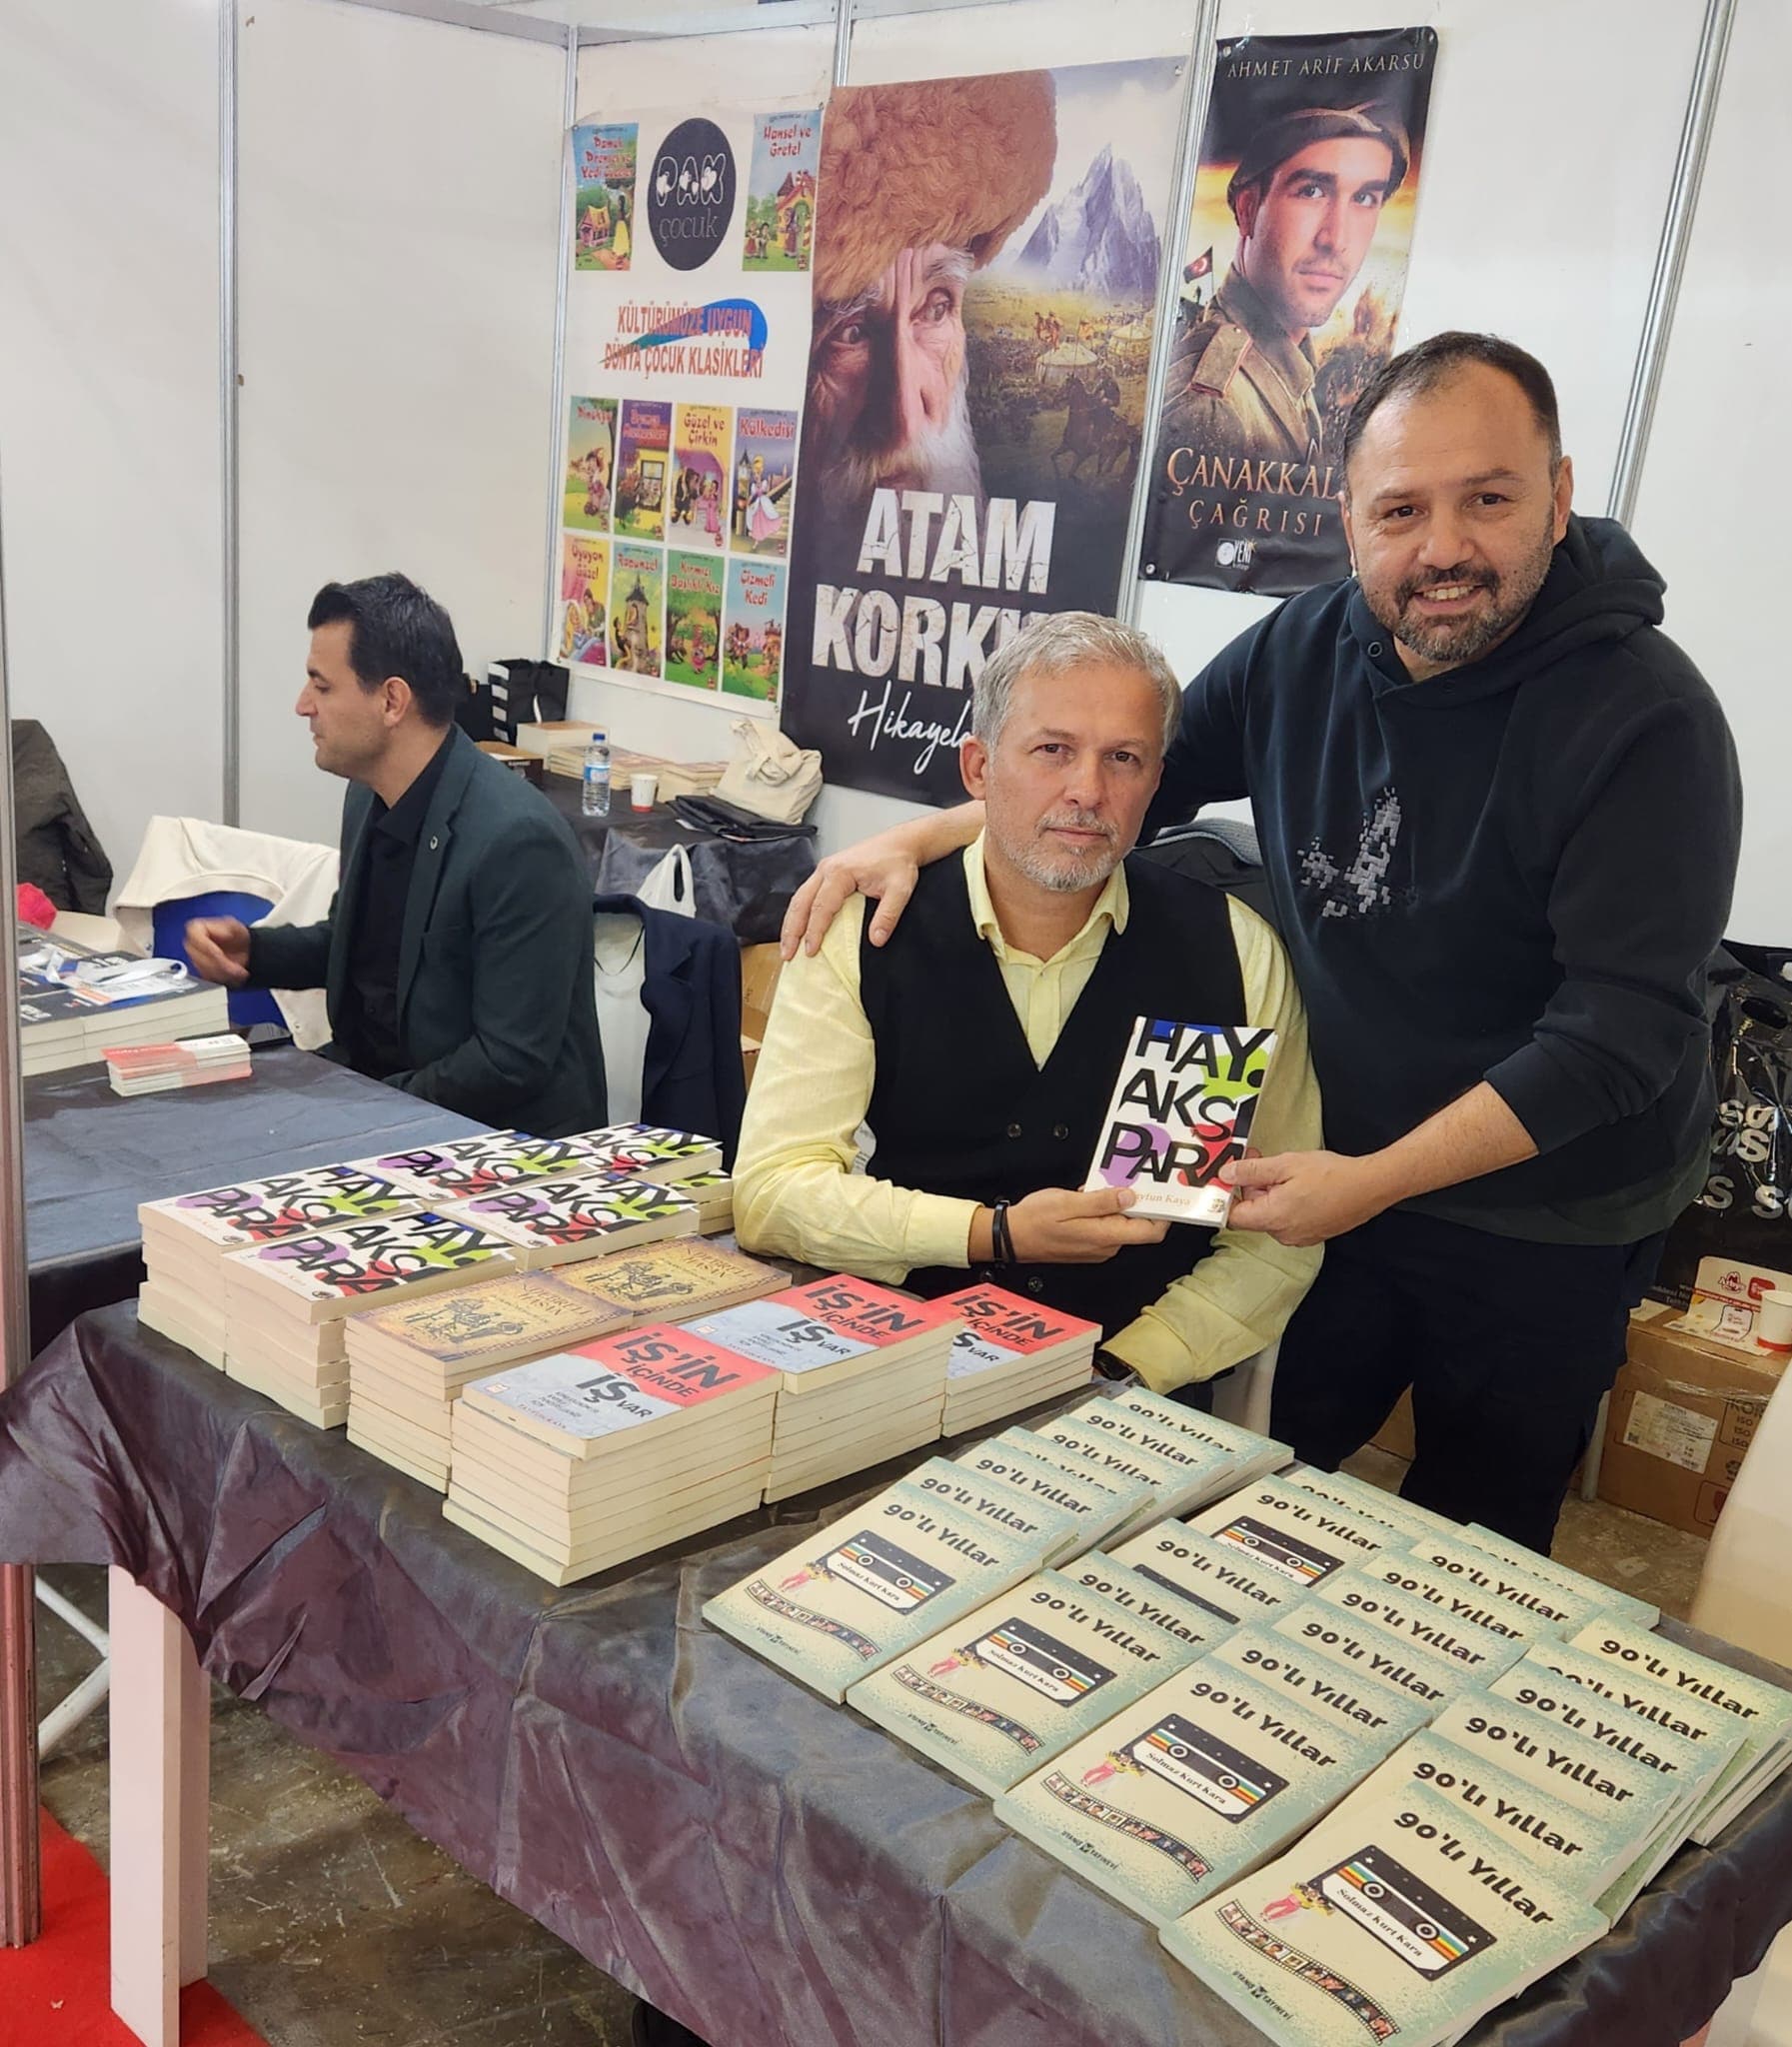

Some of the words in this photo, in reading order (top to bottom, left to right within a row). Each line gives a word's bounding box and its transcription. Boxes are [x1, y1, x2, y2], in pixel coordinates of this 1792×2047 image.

[1228, 59, 1292, 78] AHMET
[1299, 56, 1344, 77] ARİF
[1350, 53, 1425, 73] AKARSU
[770, 141, 802, 157] Gretel
[660, 207, 719, 247] çocuk
[617, 301, 705, 336] KÜLTÜRÜMÜZE
[707, 308, 753, 338] UYGUN
[603, 338, 642, 372] DÜNYA
[643, 345, 686, 380] ÇOCUK
[688, 340, 764, 379] KLASİKLERİ
[684, 413, 711, 429] Güzel
[714, 420, 726, 432] ve
[1166, 446, 1339, 500] ÇANAKKAL
[1188, 497, 1323, 537] ÇAĞRISI
[857, 487, 1056, 594] ATAM
[813, 584, 1049, 690] KORK
[382, 1149, 502, 1195] PARA
[186, 1187, 312, 1238] PARA
[475, 1191, 603, 1244] PARA
[268, 1235, 401, 1296] PARA
[820, 1309, 892, 1340] İÇİNDE
[967, 1318, 1034, 1346] İÇİNDE
[818, 1339, 852, 1355] VAR
[967, 1347, 1000, 1362] VAR
[626, 1363, 702, 1399] İÇİNDE
[616, 1400, 655, 1419] VAR
[1140, 1433, 1200, 1466] Yıllar
[1030, 1478, 1092, 1514] Yıllar
[975, 1501, 1038, 1535] Yıllar
[1315, 1515, 1383, 1552] Yıllar
[936, 1526, 1000, 1567] Yıllar
[1214, 1566, 1282, 1607] Yıllar
[1495, 1581, 1570, 1624] Yıllar
[1136, 1603, 1206, 1646] Yıllar
[1448, 1597, 1525, 1641] Yıllar
[1090, 1618, 1163, 1664] Yıllar
[1409, 1619, 1487, 1666] Yıllar
[1367, 1652, 1446, 1701] Yıllar
[1676, 1670, 1761, 1722] Yıllar
[1307, 1680, 1389, 1729] Yıllar
[1257, 1713, 1338, 1768] Yıllar
[1592, 1721, 1679, 1776] Yıllar
[1179, 1771, 1202, 1789] Kurt
[1201, 1785, 1226, 1804] Kara
[1544, 1749, 1636, 1805] Yıllar
[1491, 1798, 1585, 1858] Yıllar
[1462, 1856, 1555, 1927] Yıllar
[1336, 1887, 1374, 1918] Solmaz
[1372, 1914, 1398, 1936] Kurt
[1395, 1933, 1423, 1957] Kara
